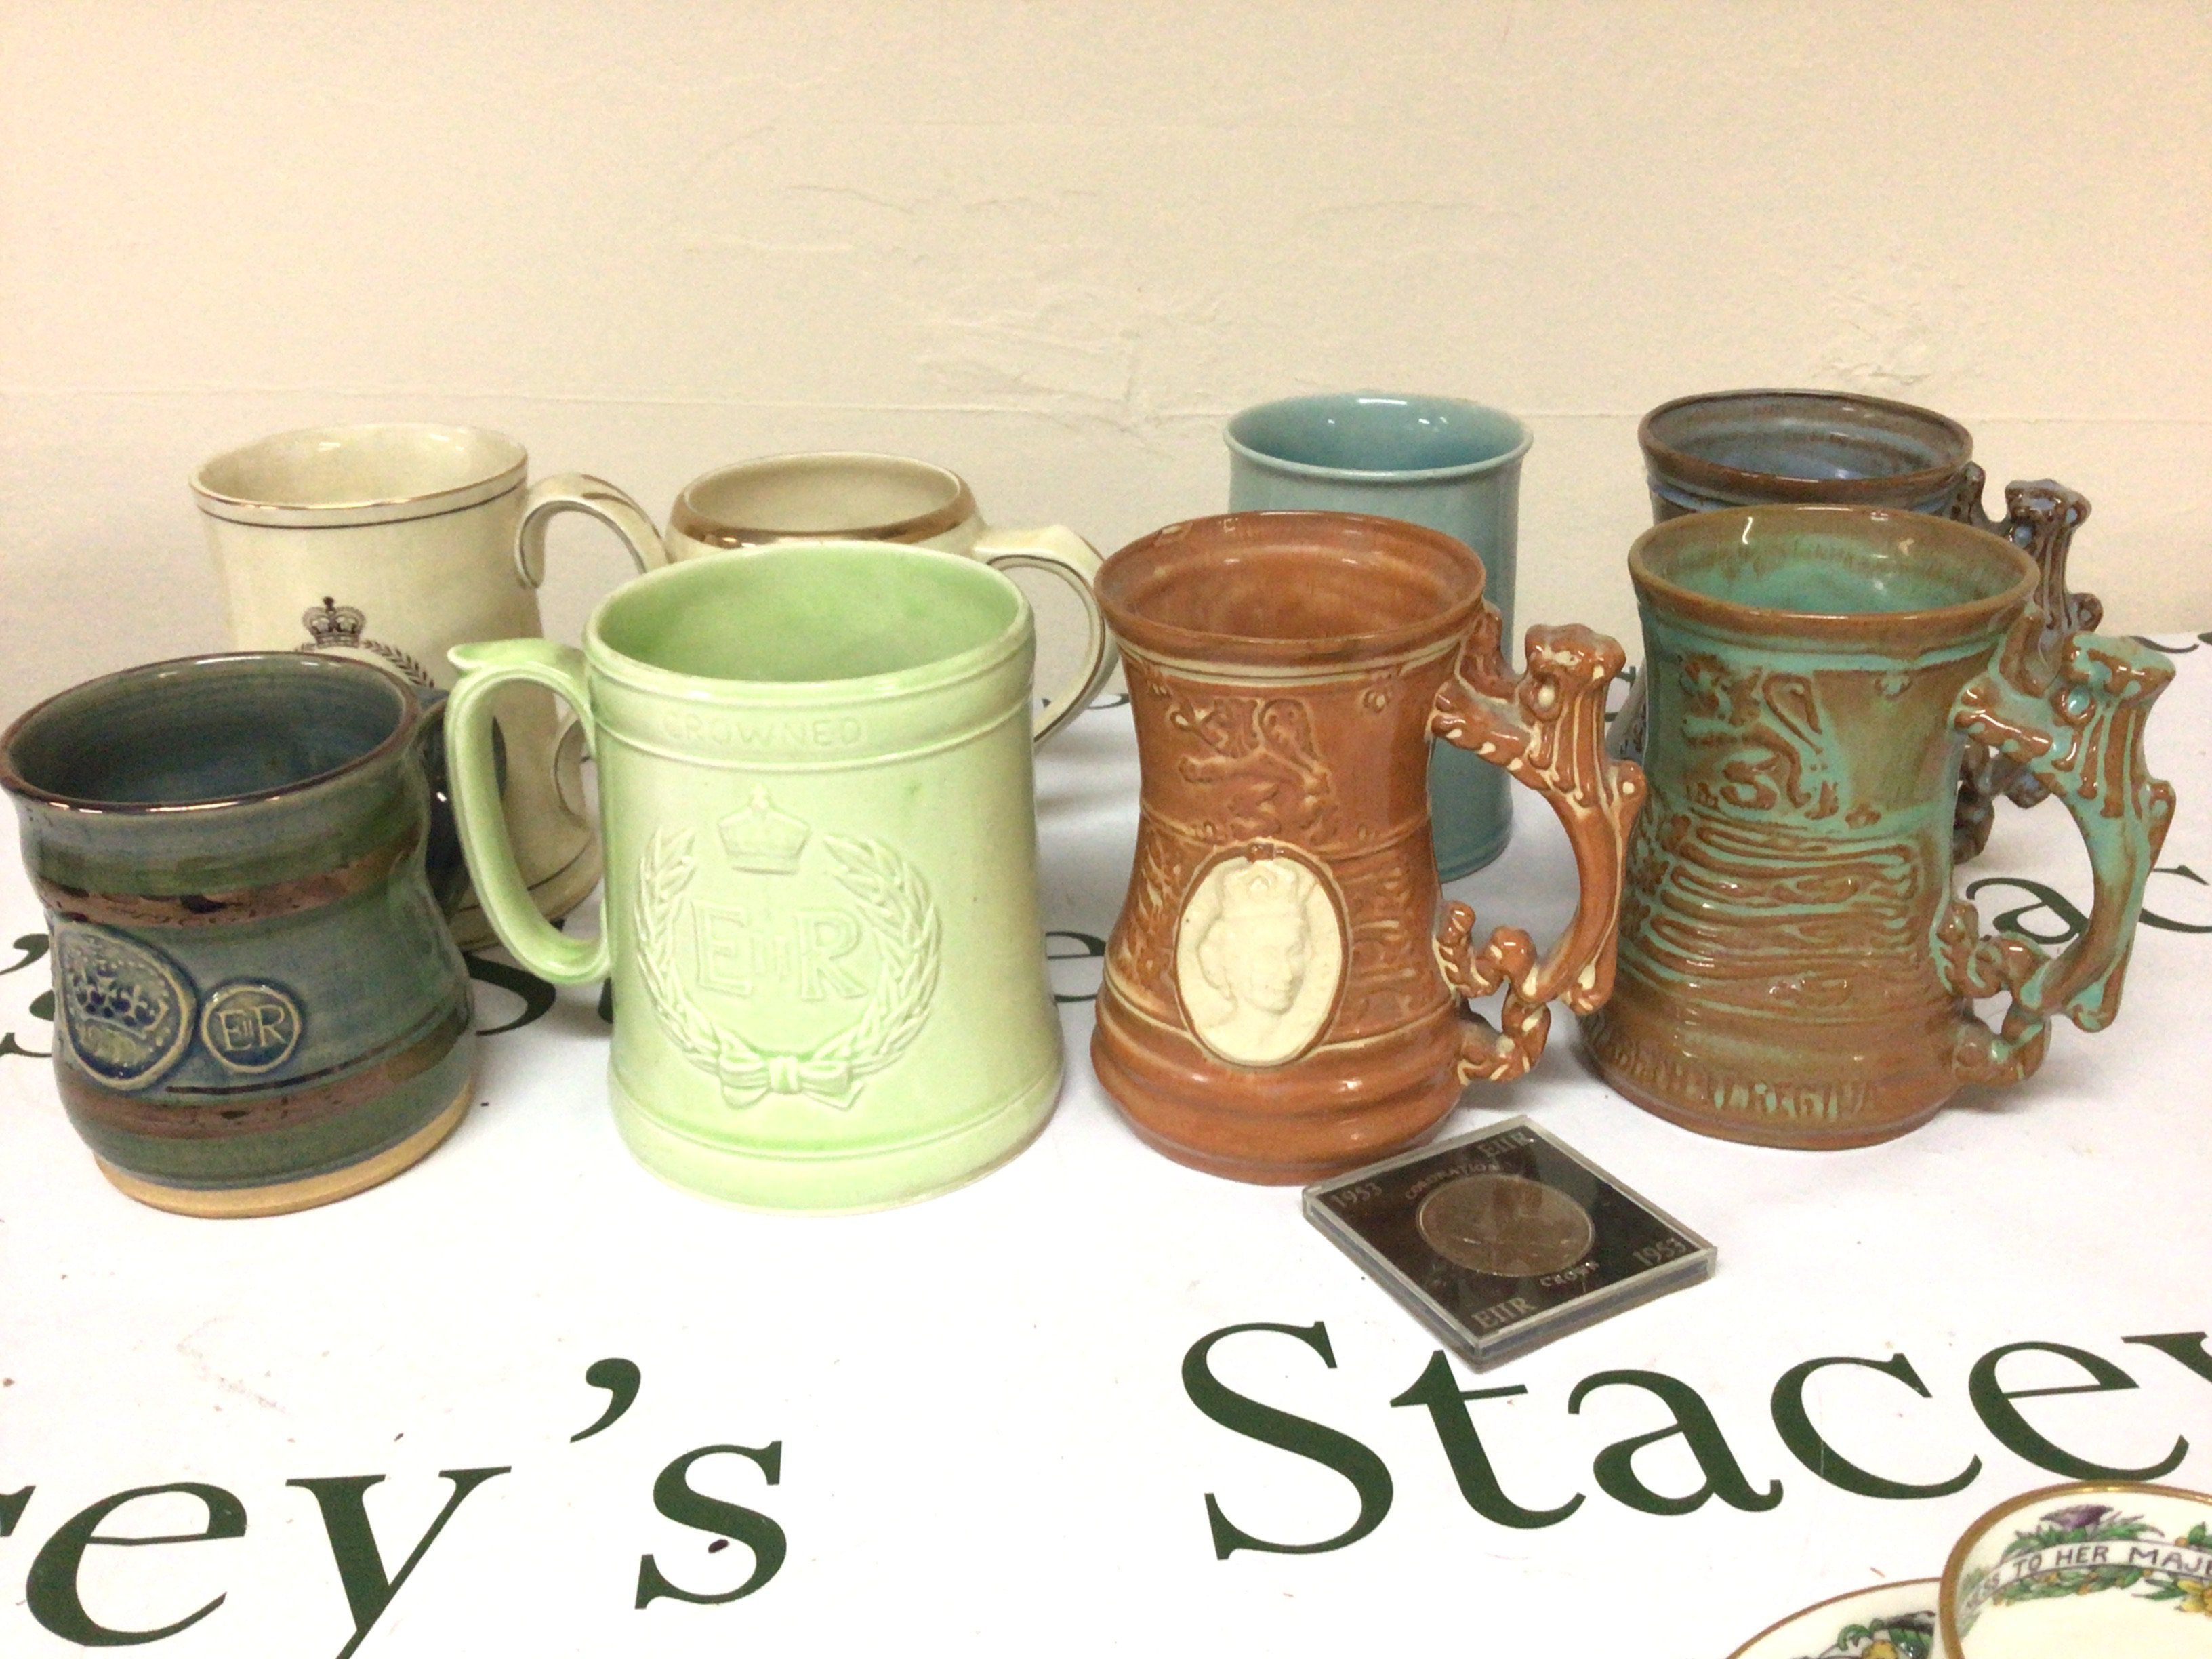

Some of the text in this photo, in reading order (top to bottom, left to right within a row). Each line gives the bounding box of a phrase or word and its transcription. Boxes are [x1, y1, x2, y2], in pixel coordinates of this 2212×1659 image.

[662, 711, 863, 747] CROWNED
[1330, 1183, 1382, 1208] 1953
[1631, 1237, 1687, 1267] 1953
[1470, 1296, 1537, 1330] EIIR
[0, 1357, 787, 1659] ey's
[2013, 1554, 2043, 1578] TO
[2055, 1545, 2109, 1566] HER
